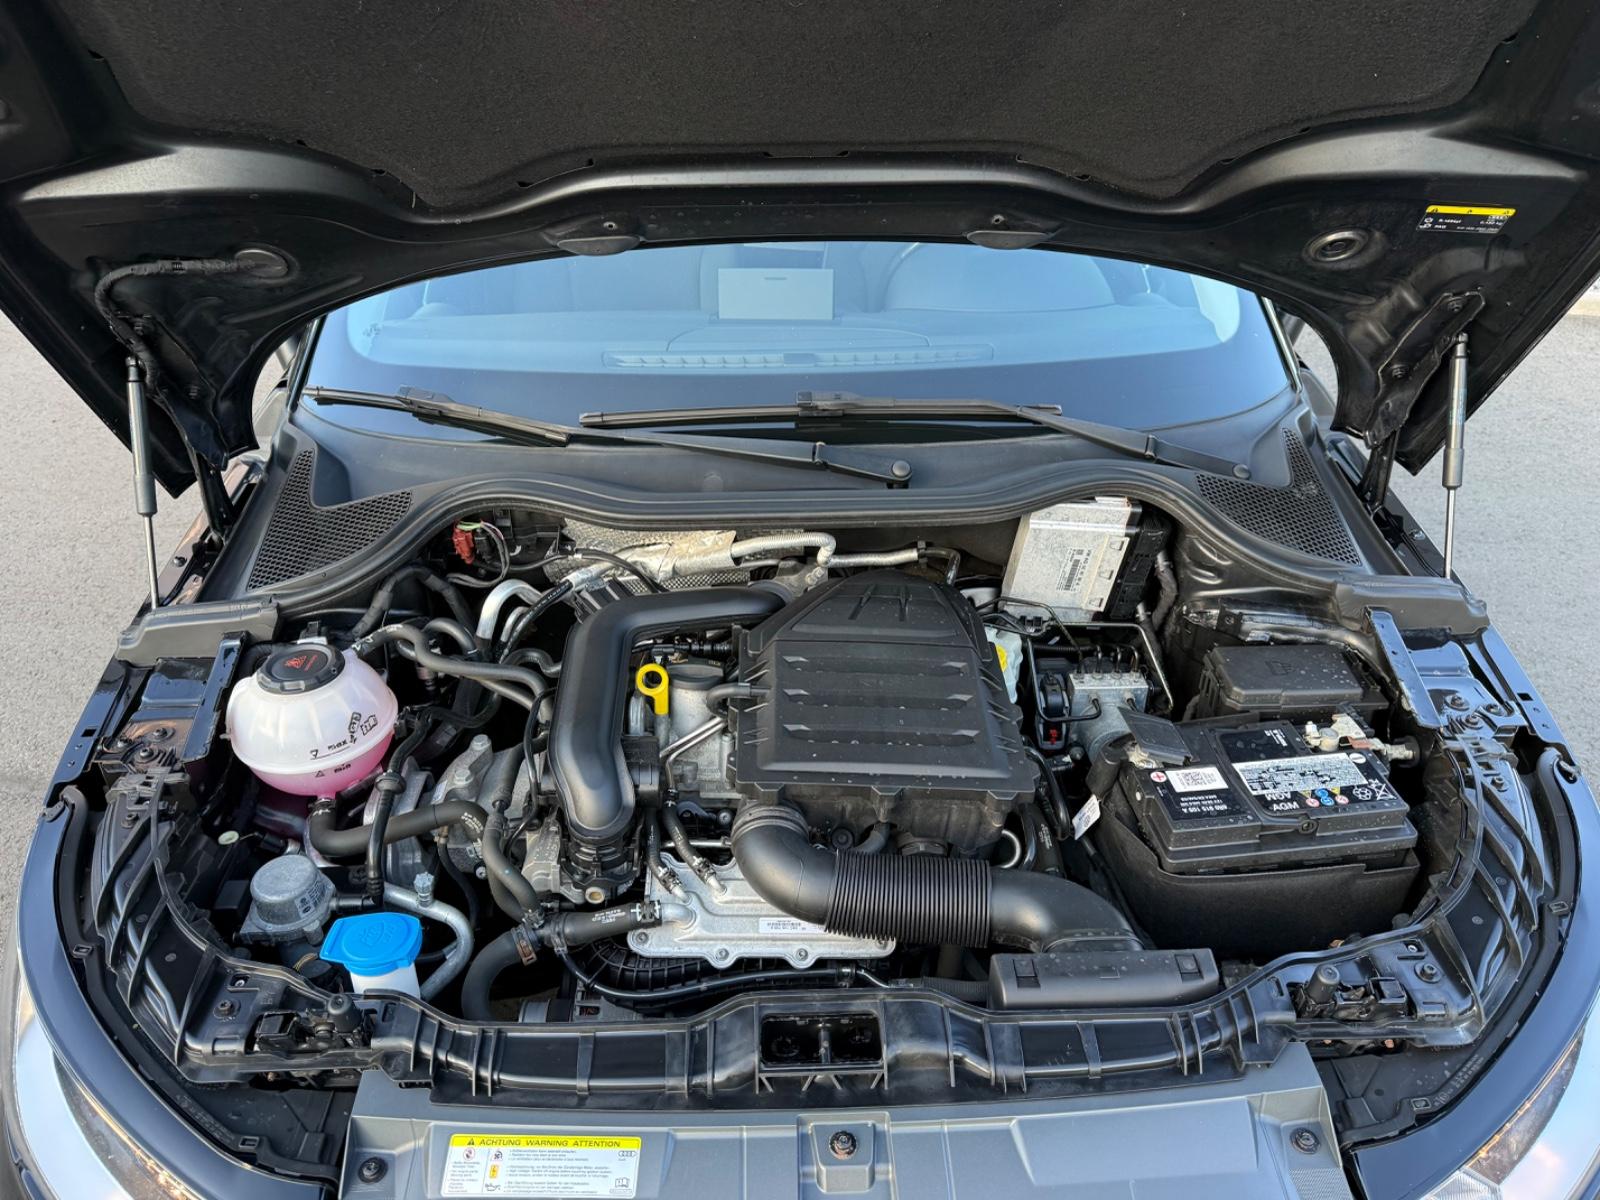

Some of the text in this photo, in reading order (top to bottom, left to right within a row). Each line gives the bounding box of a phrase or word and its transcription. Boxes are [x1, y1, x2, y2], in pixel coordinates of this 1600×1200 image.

[327, 739, 348, 751] max
[1273, 801, 1300, 811] AGM
[479, 1139, 521, 1147] ACHTUNG
